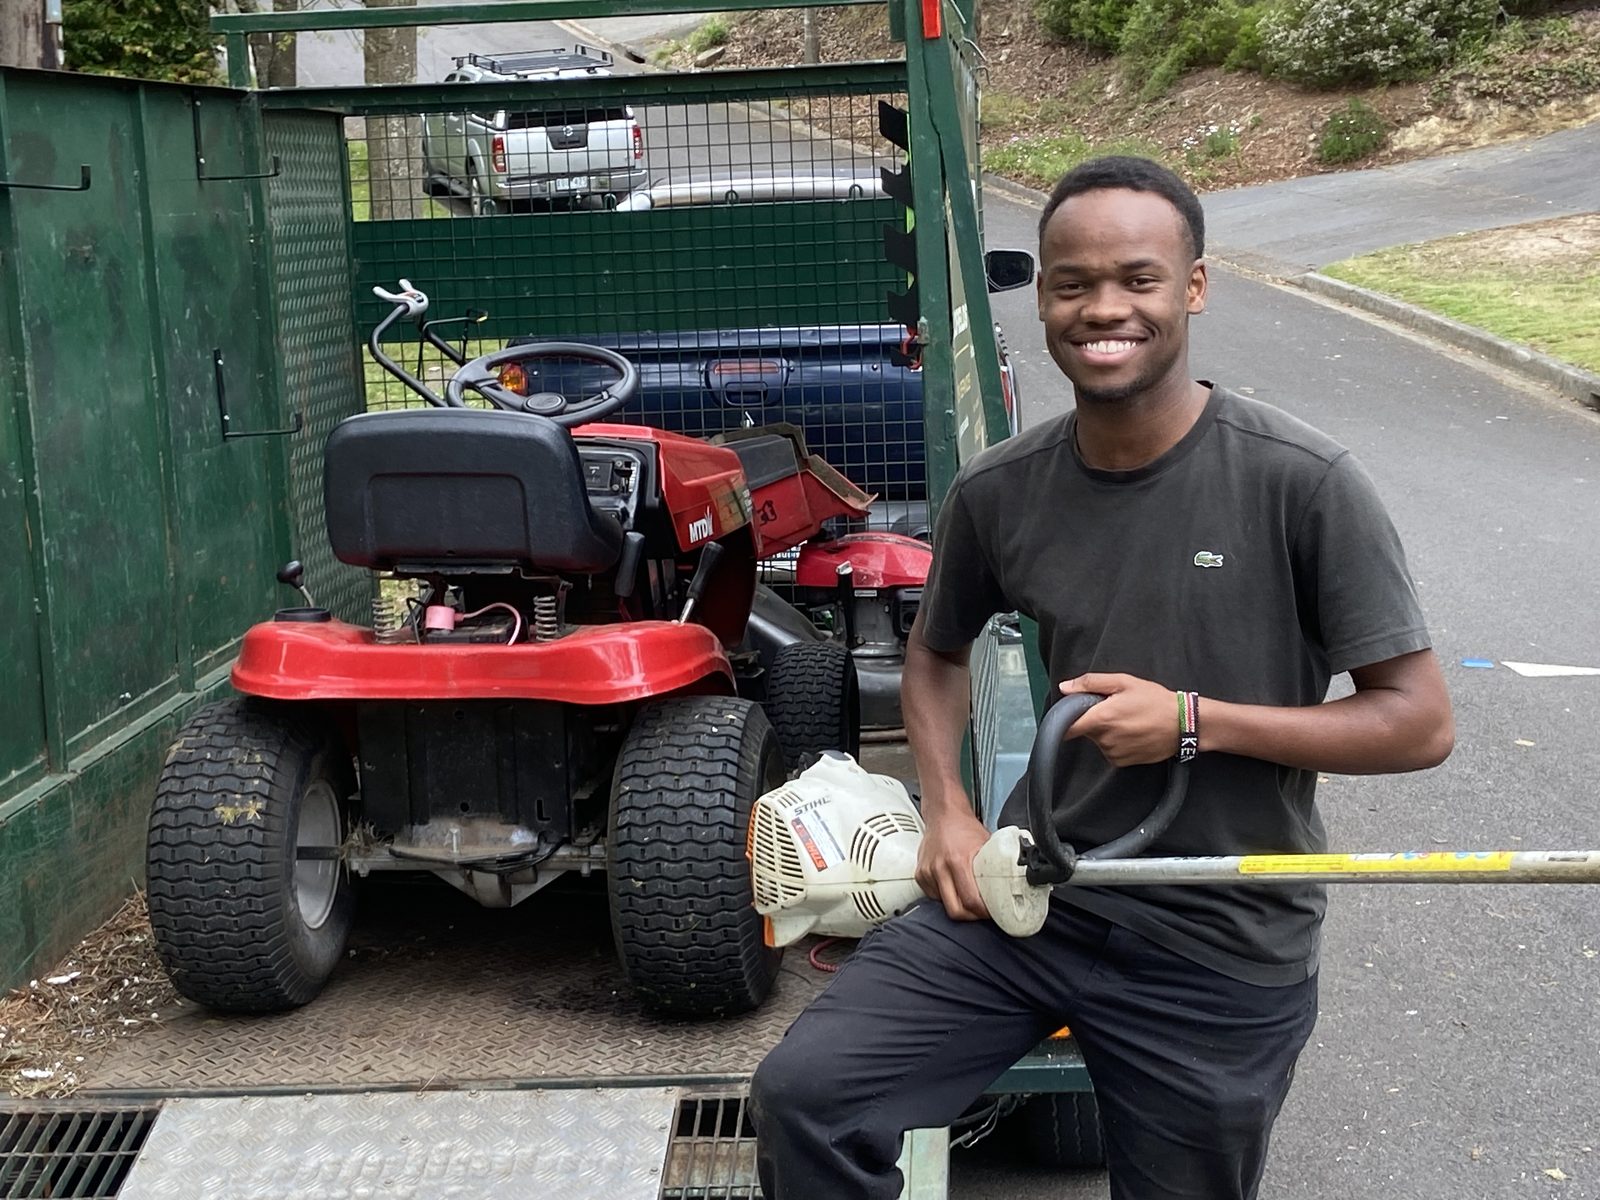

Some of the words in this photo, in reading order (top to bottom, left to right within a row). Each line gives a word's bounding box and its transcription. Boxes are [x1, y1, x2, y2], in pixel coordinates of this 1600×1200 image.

[689, 518, 708, 543] MTD
[794, 797, 832, 816] STIHL
[804, 837, 827, 870] STIHL
